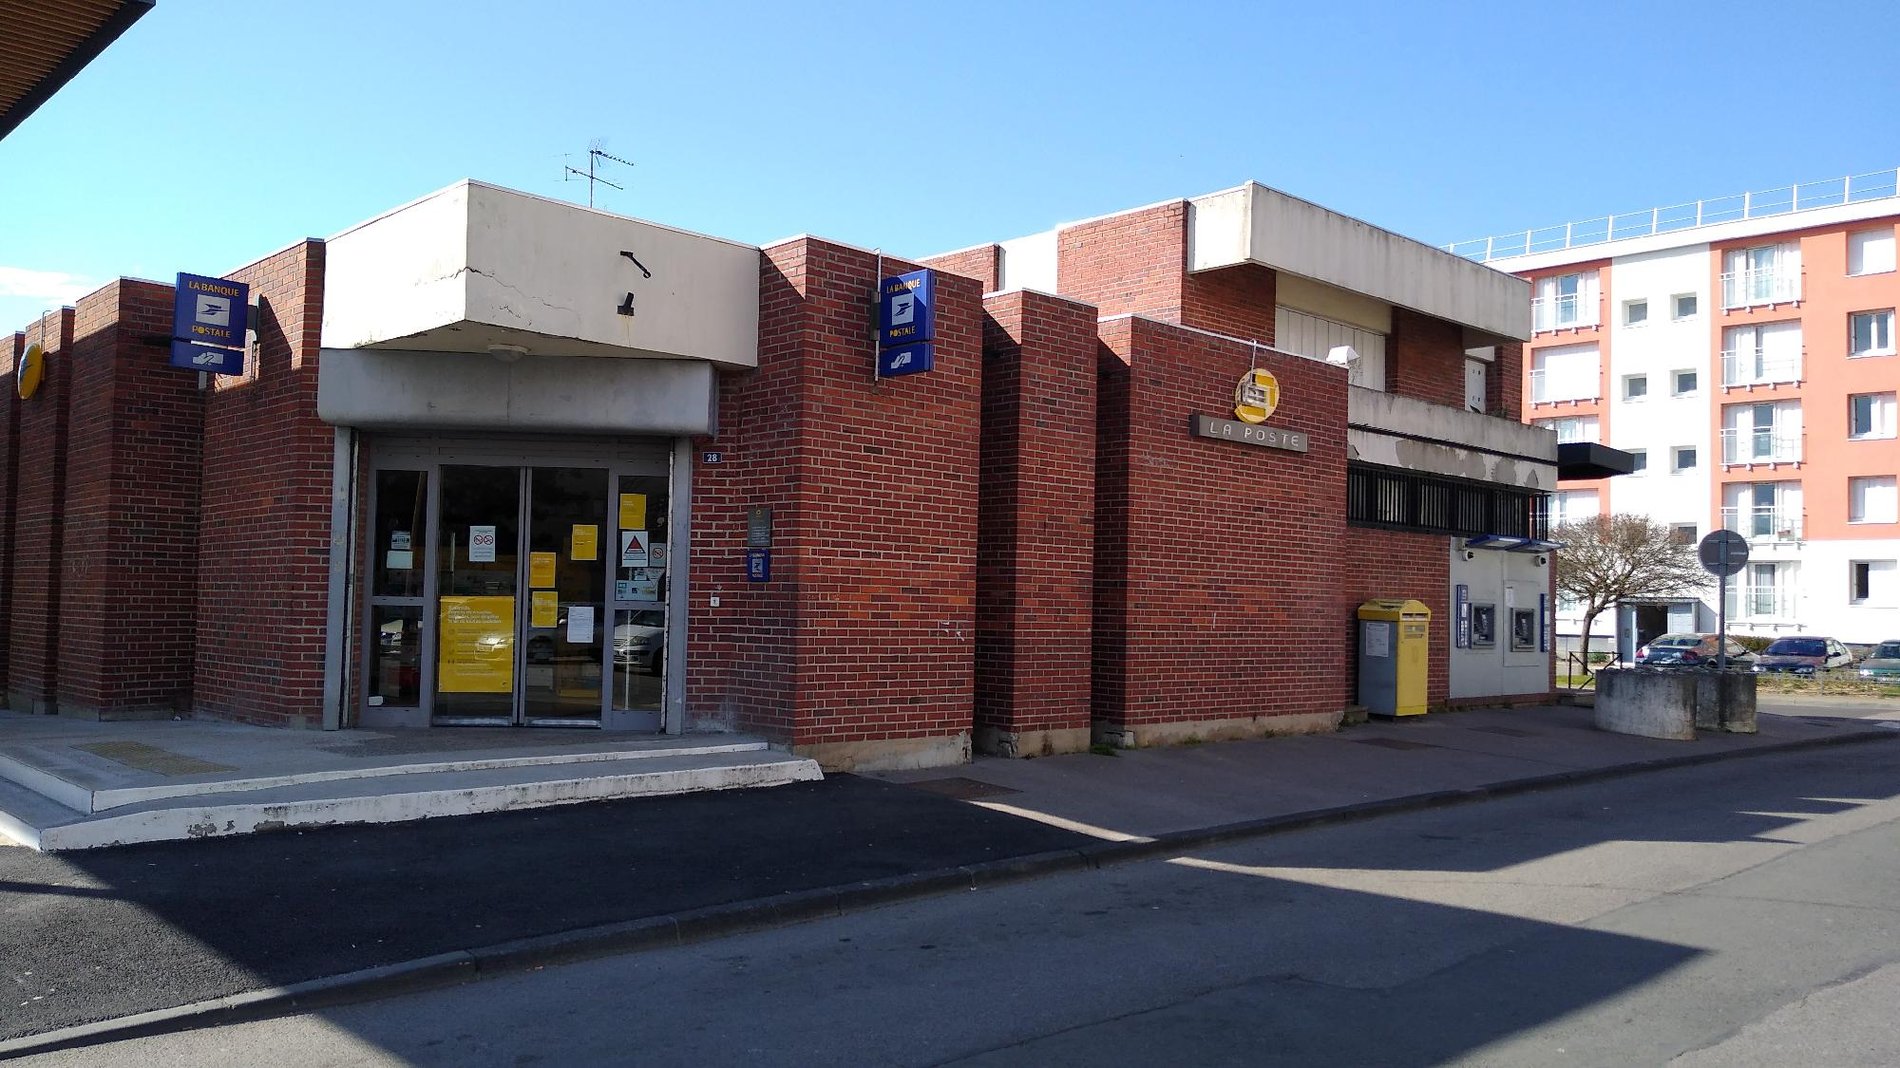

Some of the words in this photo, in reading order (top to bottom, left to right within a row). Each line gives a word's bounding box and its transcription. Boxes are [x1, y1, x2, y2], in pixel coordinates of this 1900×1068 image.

[188, 281, 200, 290] LA
[201, 284, 239, 297] BANQUE
[886, 285, 893, 293] LA
[894, 278, 920, 291] BANQUE
[192, 325, 232, 338] POSTALE
[889, 326, 915, 338] POSTALE
[1209, 421, 1231, 436] LA
[1244, 427, 1299, 447] POSTE
[706, 453, 718, 462] 28
